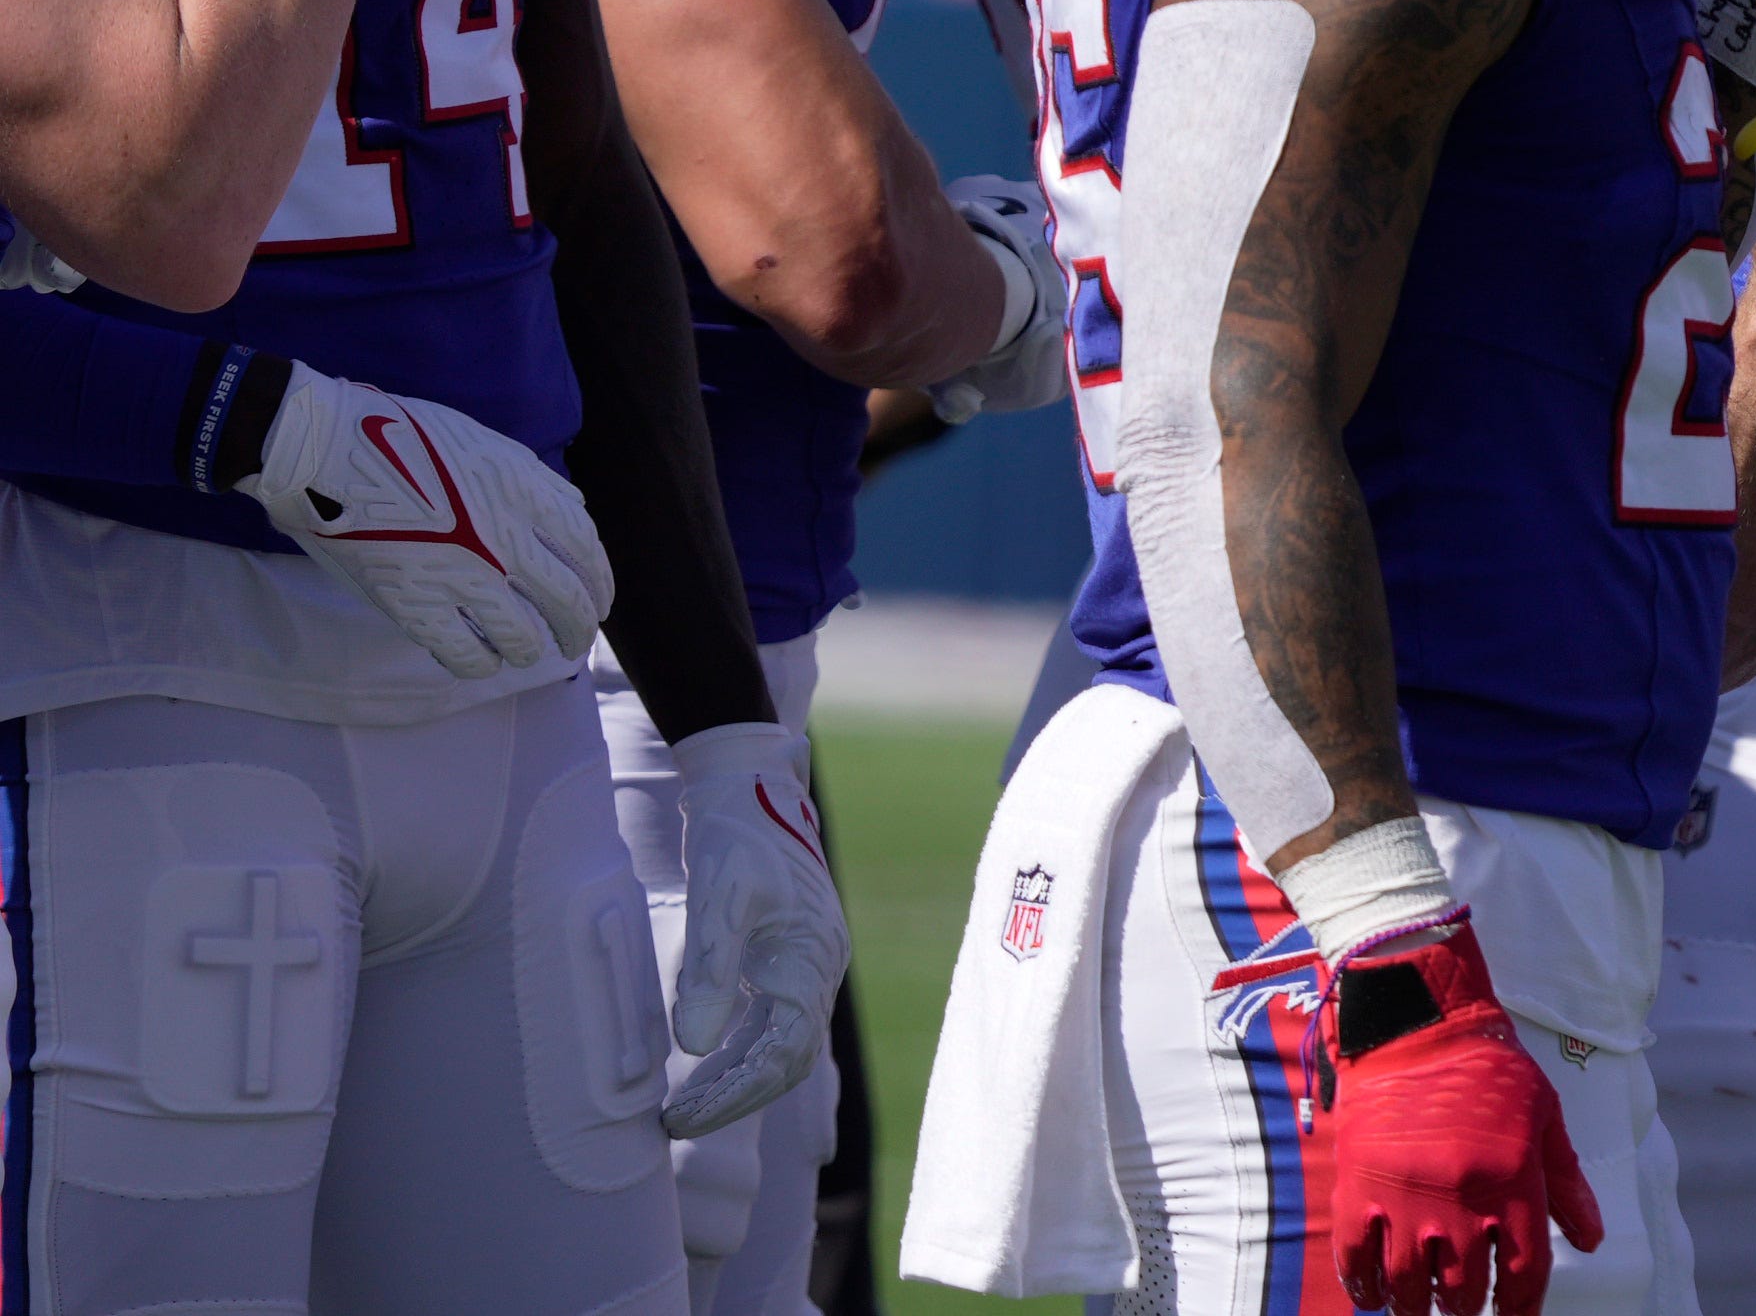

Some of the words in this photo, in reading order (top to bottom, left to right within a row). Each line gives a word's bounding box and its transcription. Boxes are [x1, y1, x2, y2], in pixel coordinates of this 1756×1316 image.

[213, 363, 239, 403] SEEK
[197, 404, 222, 454] FIRST
[194, 456, 207, 480] HIS
[1005, 904, 1044, 952] NFL
